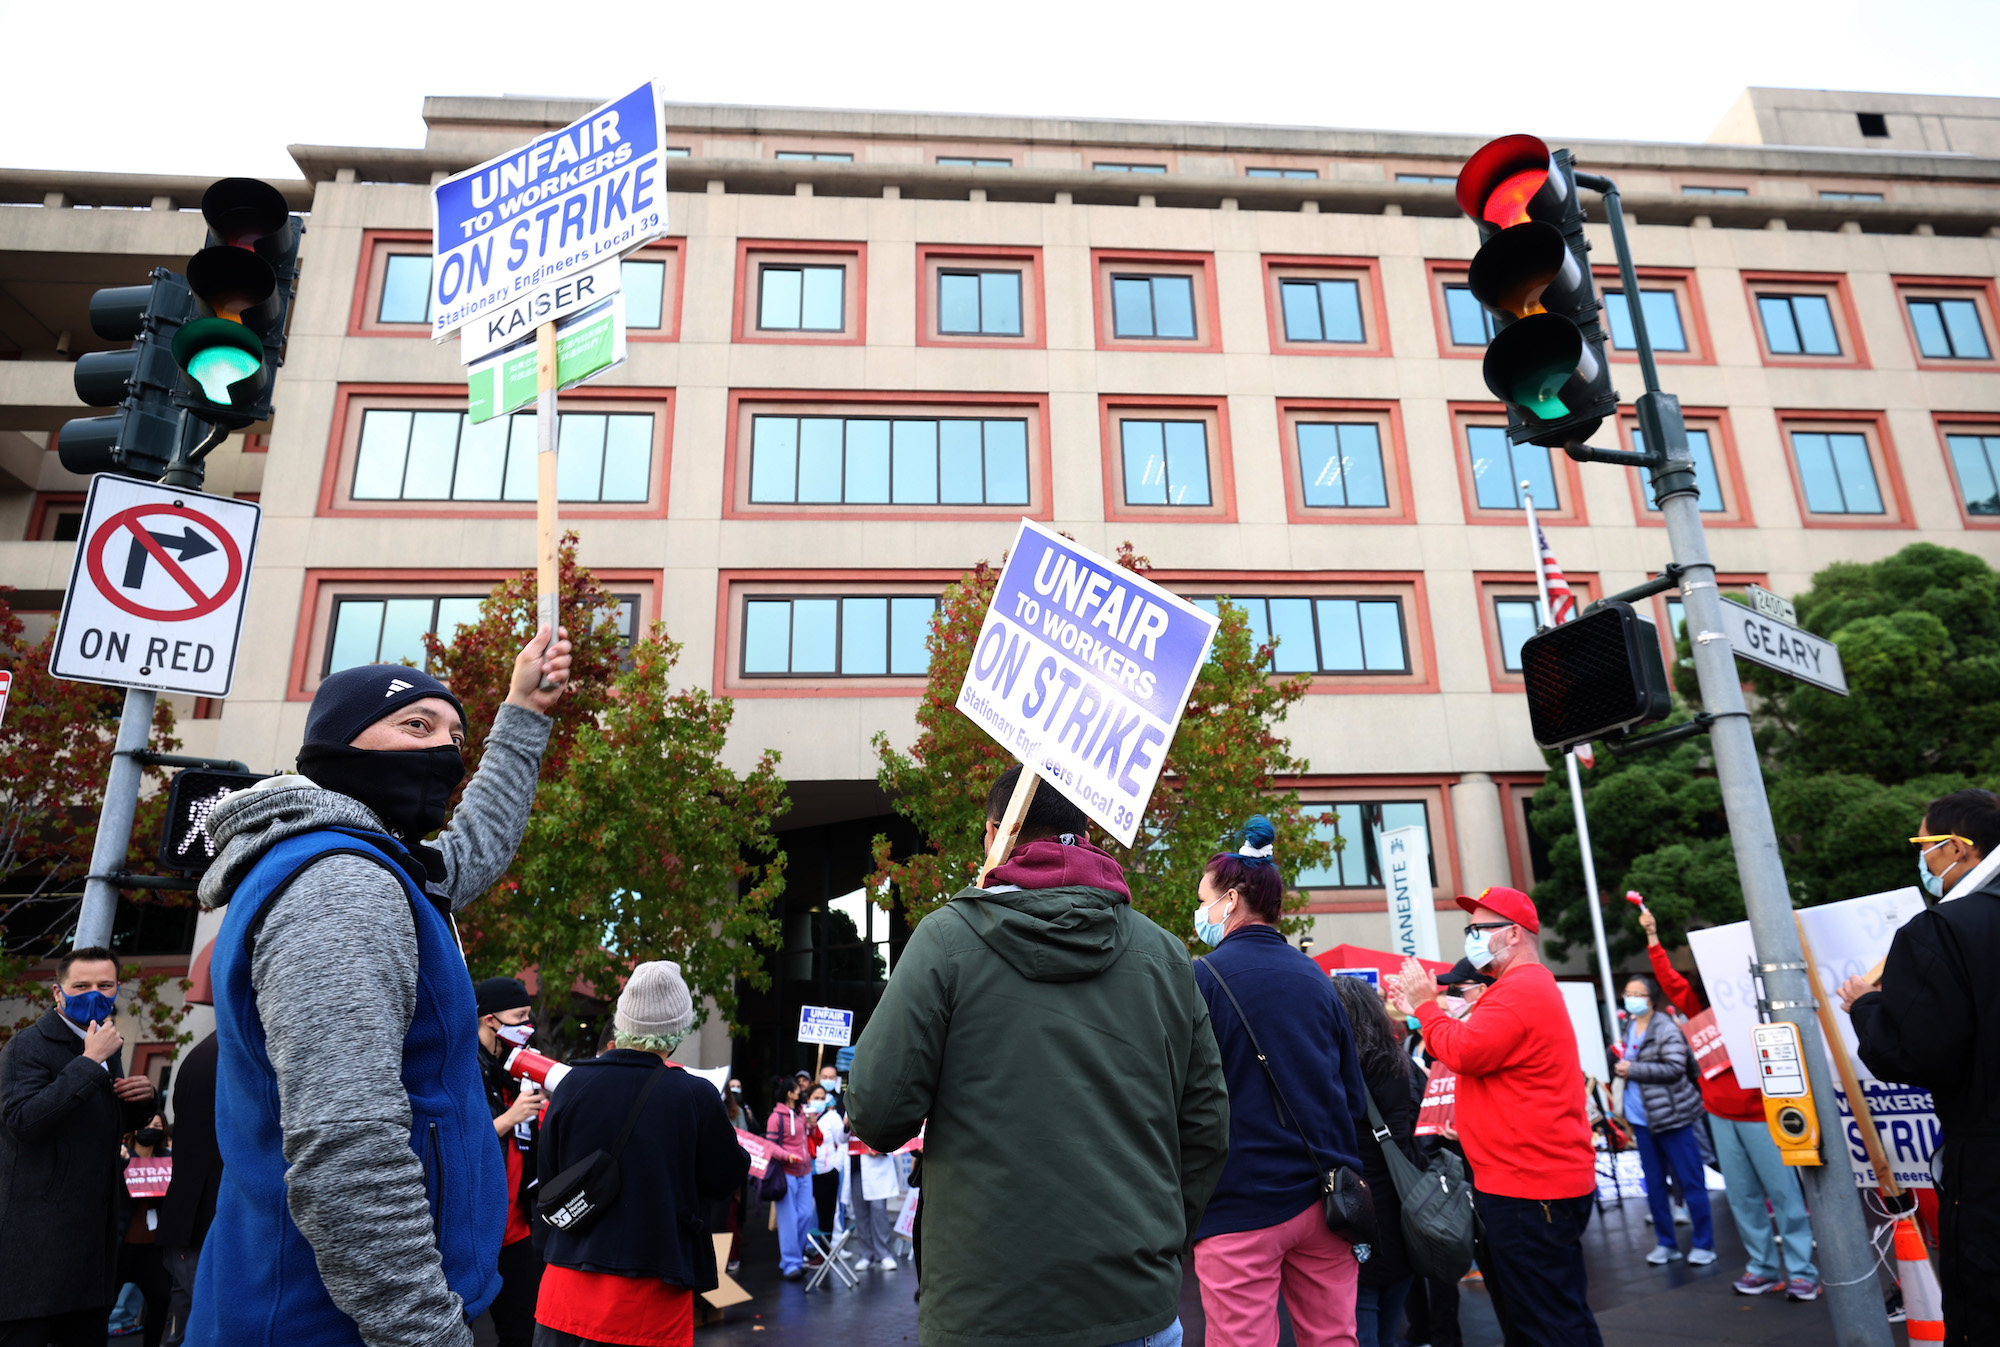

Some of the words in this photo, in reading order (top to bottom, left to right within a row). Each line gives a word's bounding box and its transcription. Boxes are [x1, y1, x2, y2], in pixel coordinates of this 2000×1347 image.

[471, 110, 621, 209] UNFAIR
[460, 210, 493, 239] TO
[498, 142, 633, 220] WORKERS
[438, 236, 494, 305] ON
[507, 158, 658, 271] STRIKE
[438, 285, 509, 330] Stationary
[514, 251, 589, 291] Engineers
[595, 230, 635, 255] Local
[640, 213, 659, 232] 39
[488, 275, 596, 343] KAISER
[1033, 547, 1169, 661] UNFAIR
[1757, 591, 1784, 617] 2400
[80, 628, 131, 663] ON
[145, 637, 215, 674] RED
[1014, 591, 1040, 625] TO
[1043, 609, 1158, 700] WORKERS
[1744, 619, 1822, 674] GEARY
[975, 622, 1031, 699] ON
[1022, 656, 1165, 797] STRIKE
[963, 686, 1015, 741] Stationary
[1015, 728, 1073, 787] Engineers
[1075, 774, 1113, 816] Local
[1114, 805, 1134, 831] 39
[801, 1024, 814, 1035] ON
[816, 1025, 850, 1039] STRIKE
[810, 1009, 845, 1021] UNFAIR
[1691, 1024, 1721, 1047] STR
[565, 1190, 586, 1208] National
[569, 1198, 585, 1213] Nurses
[571, 1202, 589, 1217] United
